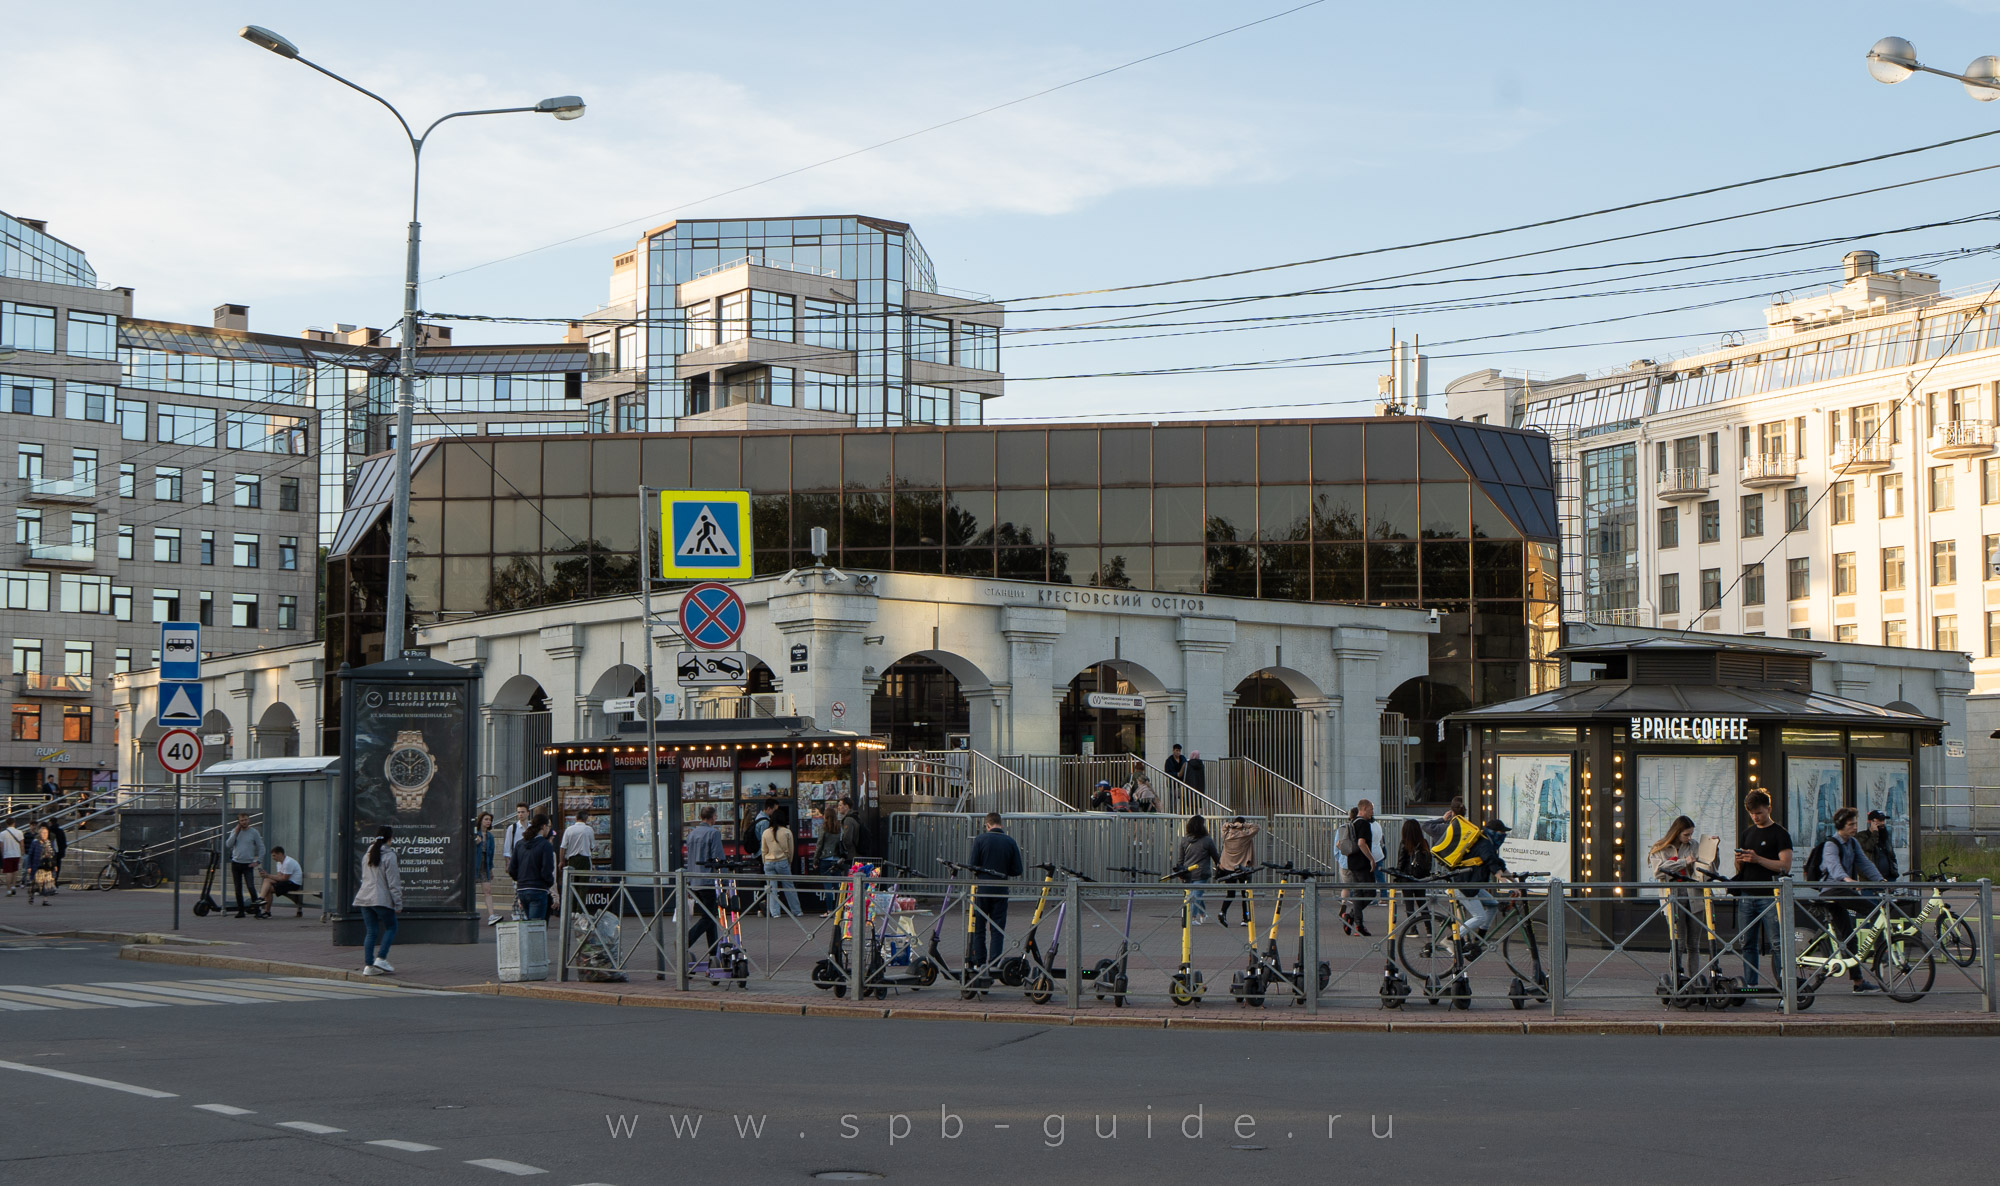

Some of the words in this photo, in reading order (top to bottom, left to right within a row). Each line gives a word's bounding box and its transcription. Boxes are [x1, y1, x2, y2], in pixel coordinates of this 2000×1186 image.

[1038, 588, 1142, 608] КРЕСТОВСКИЙ
[1151, 597, 1204, 612] ОСТРОВ
[388, 691, 457, 701] ПЕРСПЕКТИВА
[1631, 717, 1641, 739] ONE
[1643, 717, 1690, 740] PRICE
[1692, 717, 1749, 740] COFFEE
[35, 747, 57, 757] RUN
[167, 743, 193, 761] 40
[51, 754, 71, 763] LAB
[614, 757, 647, 766] BAGGINS
[655, 756, 676, 765] OFFEE
[682, 757, 732, 770] ЖУРНАЛЫ
[805, 753, 842, 766] ГАЗЕТЫ
[566, 759, 603, 771] ПРЕССА
[361, 836, 411, 845] ПРЖА
[418, 836, 451, 844] ВЫКУП
[407, 846, 444, 855] СЕРВИС
[586, 893, 610, 905] КСЫ
